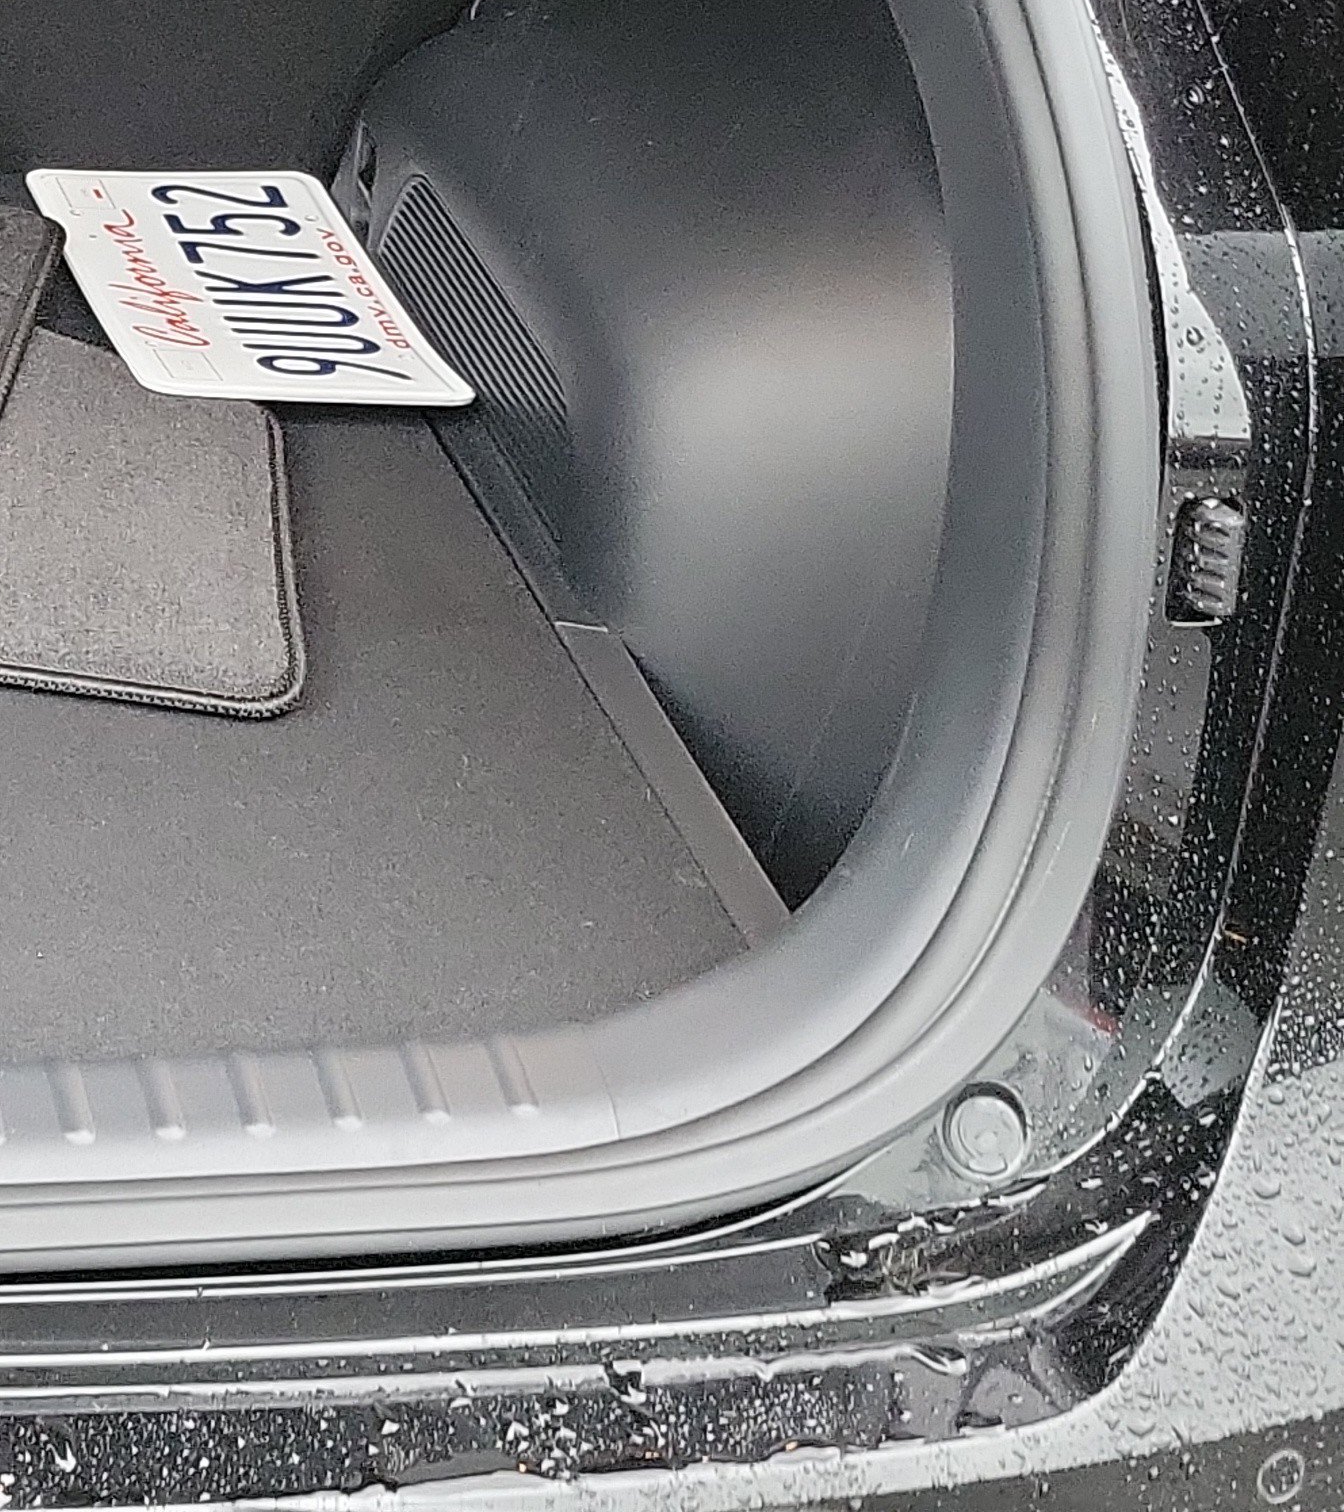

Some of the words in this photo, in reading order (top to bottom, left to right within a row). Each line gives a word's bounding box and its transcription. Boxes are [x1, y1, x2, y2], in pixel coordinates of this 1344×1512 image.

[104, 208, 212, 349] California
[150, 184, 415, 382] 9UUK752
[316, 226, 411, 350] dmv.ca.gov
